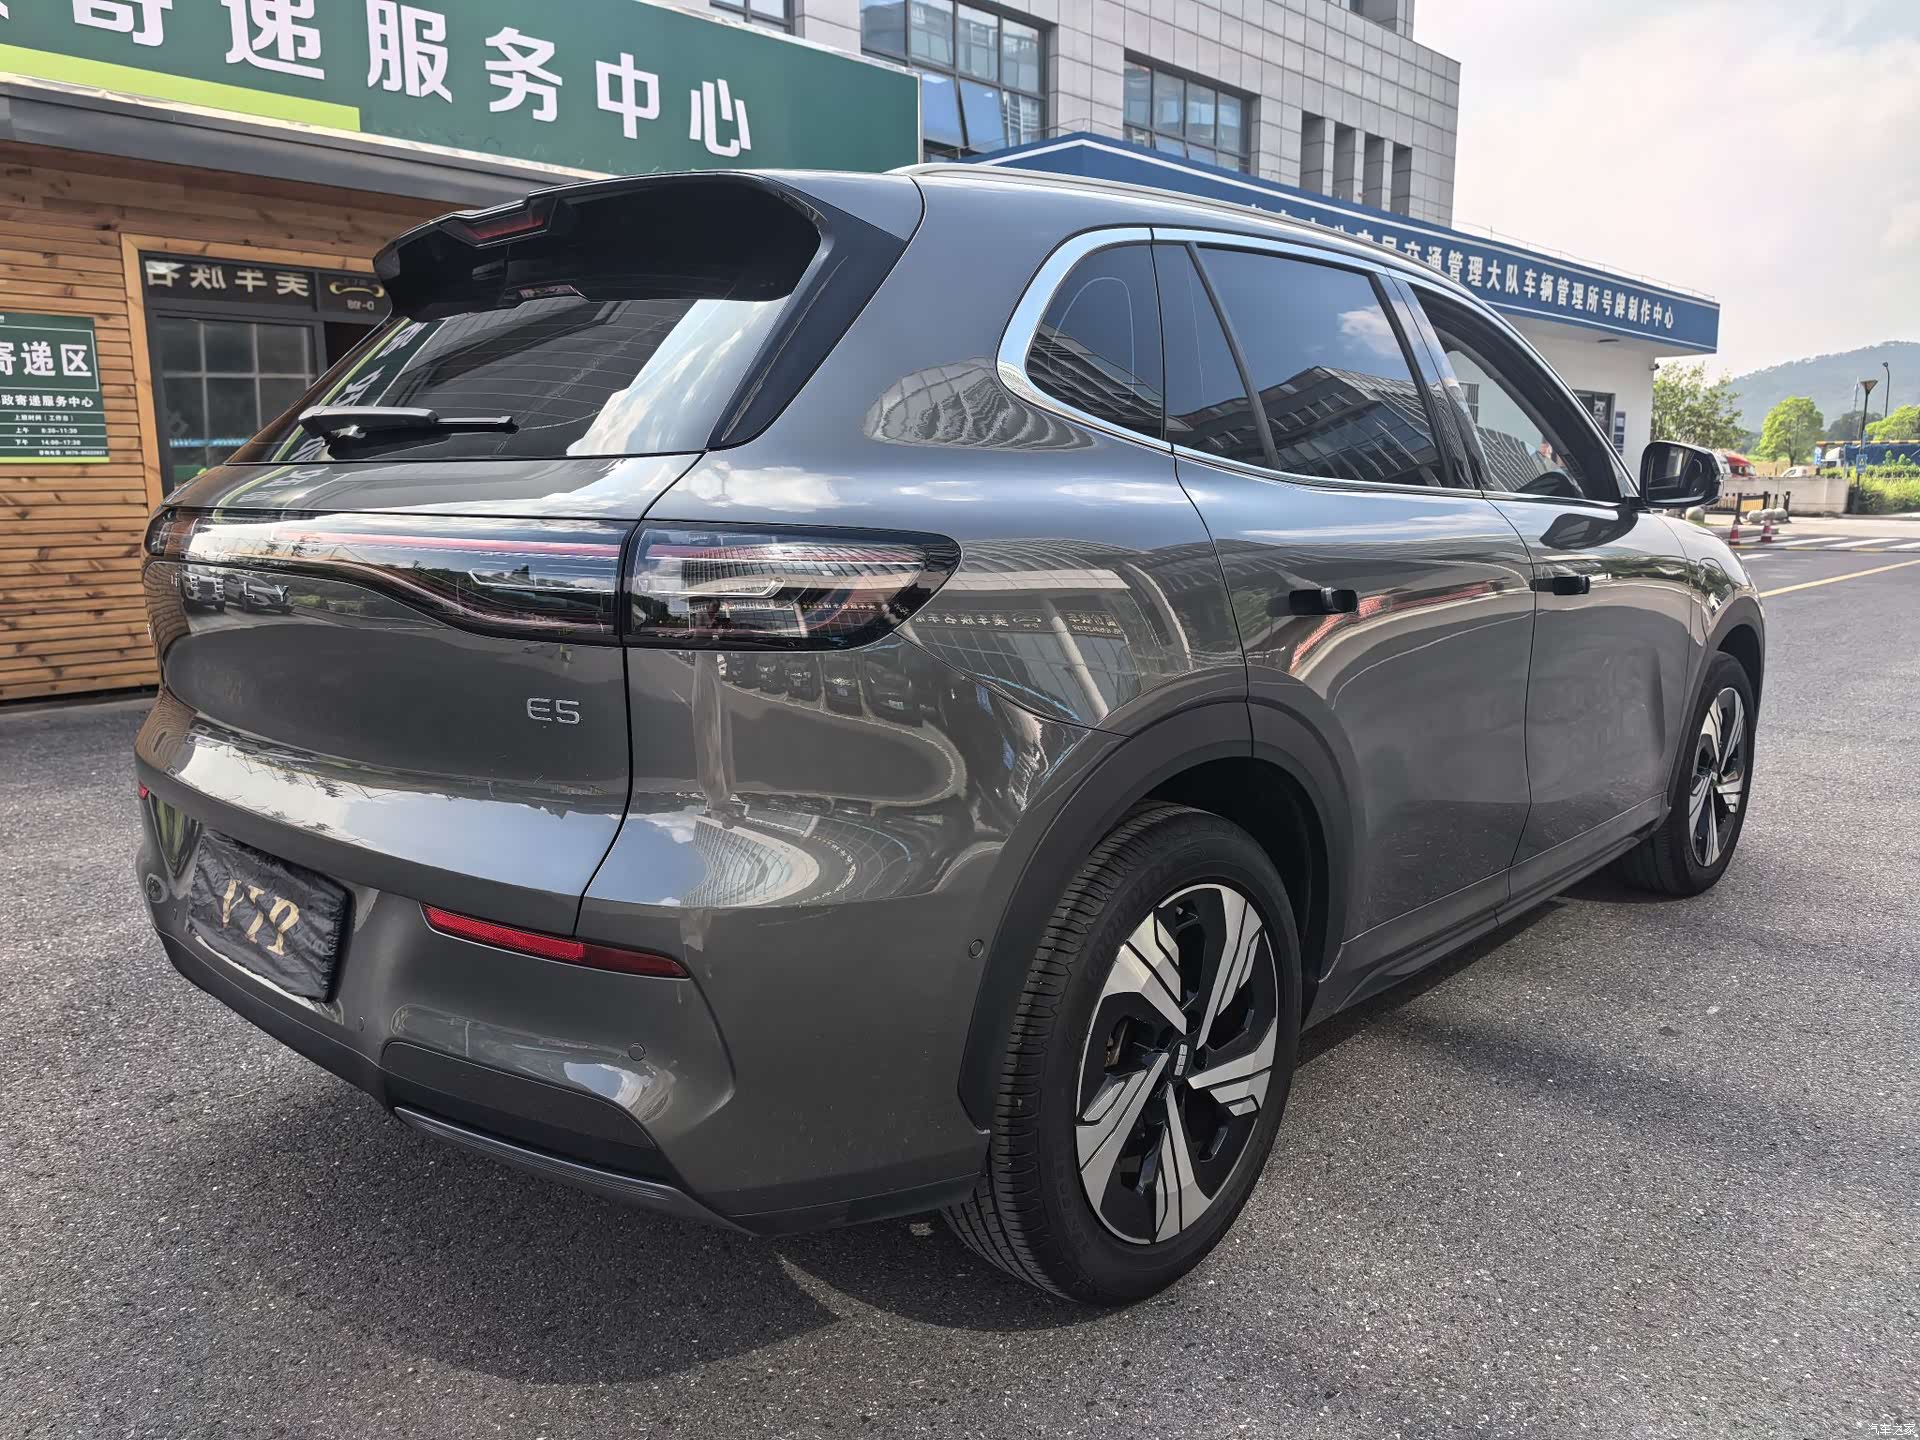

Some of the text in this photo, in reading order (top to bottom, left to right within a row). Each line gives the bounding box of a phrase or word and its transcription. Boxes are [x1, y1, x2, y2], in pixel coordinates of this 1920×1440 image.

[0, 0, 750, 157] 递服务中心
[1337, 224, 1674, 329] 交通管理大队车辆管理所号牌制作中心
[526, 698, 580, 724] E5
